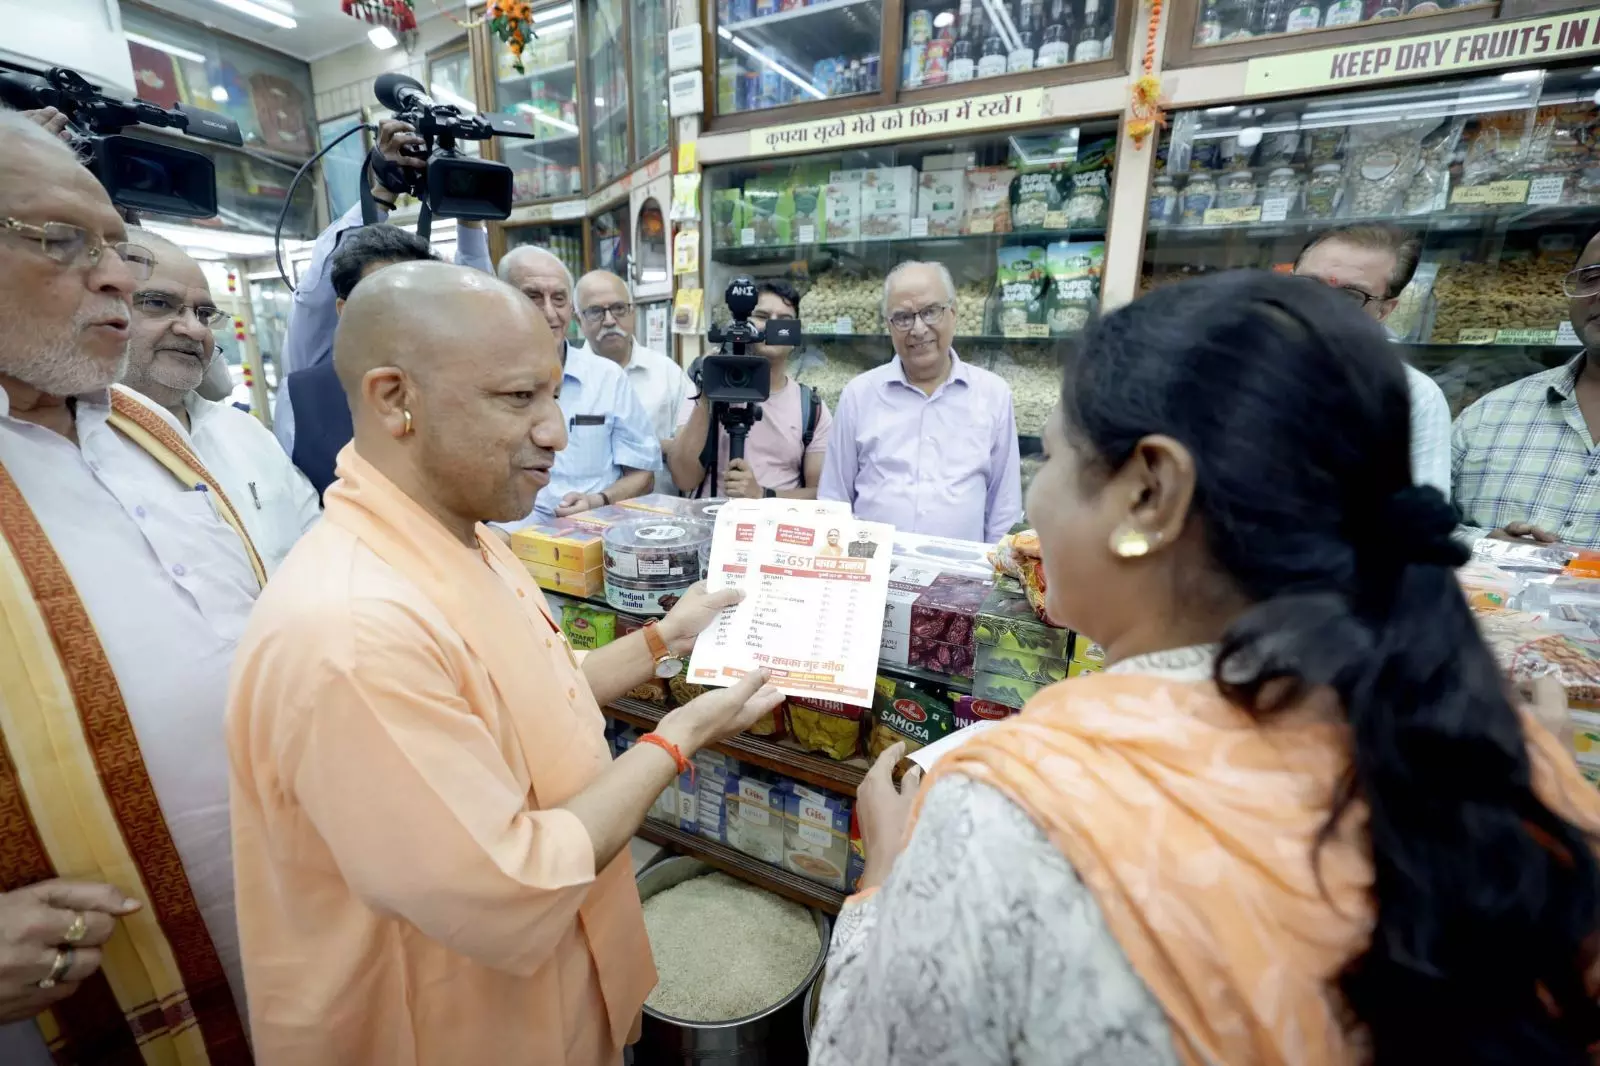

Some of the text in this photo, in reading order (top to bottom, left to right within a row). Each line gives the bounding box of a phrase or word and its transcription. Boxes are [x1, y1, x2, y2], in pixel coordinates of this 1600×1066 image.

[1330, 47, 1391, 80] KEEP
[1394, 38, 1452, 71] DRY
[1453, 23, 1553, 64] FRUITS
[1556, 17, 1590, 50] IN
[765, 128, 809, 151] कृपया
[813, 119, 846, 144] सूखे
[851, 114, 877, 135] मेवे
[881, 109, 904, 131] को
[955, 99, 973, 121] में
[732, 286, 754, 296] ANI
[787, 556, 813, 567] GST
[880, 709, 930, 740] SAMOSA
